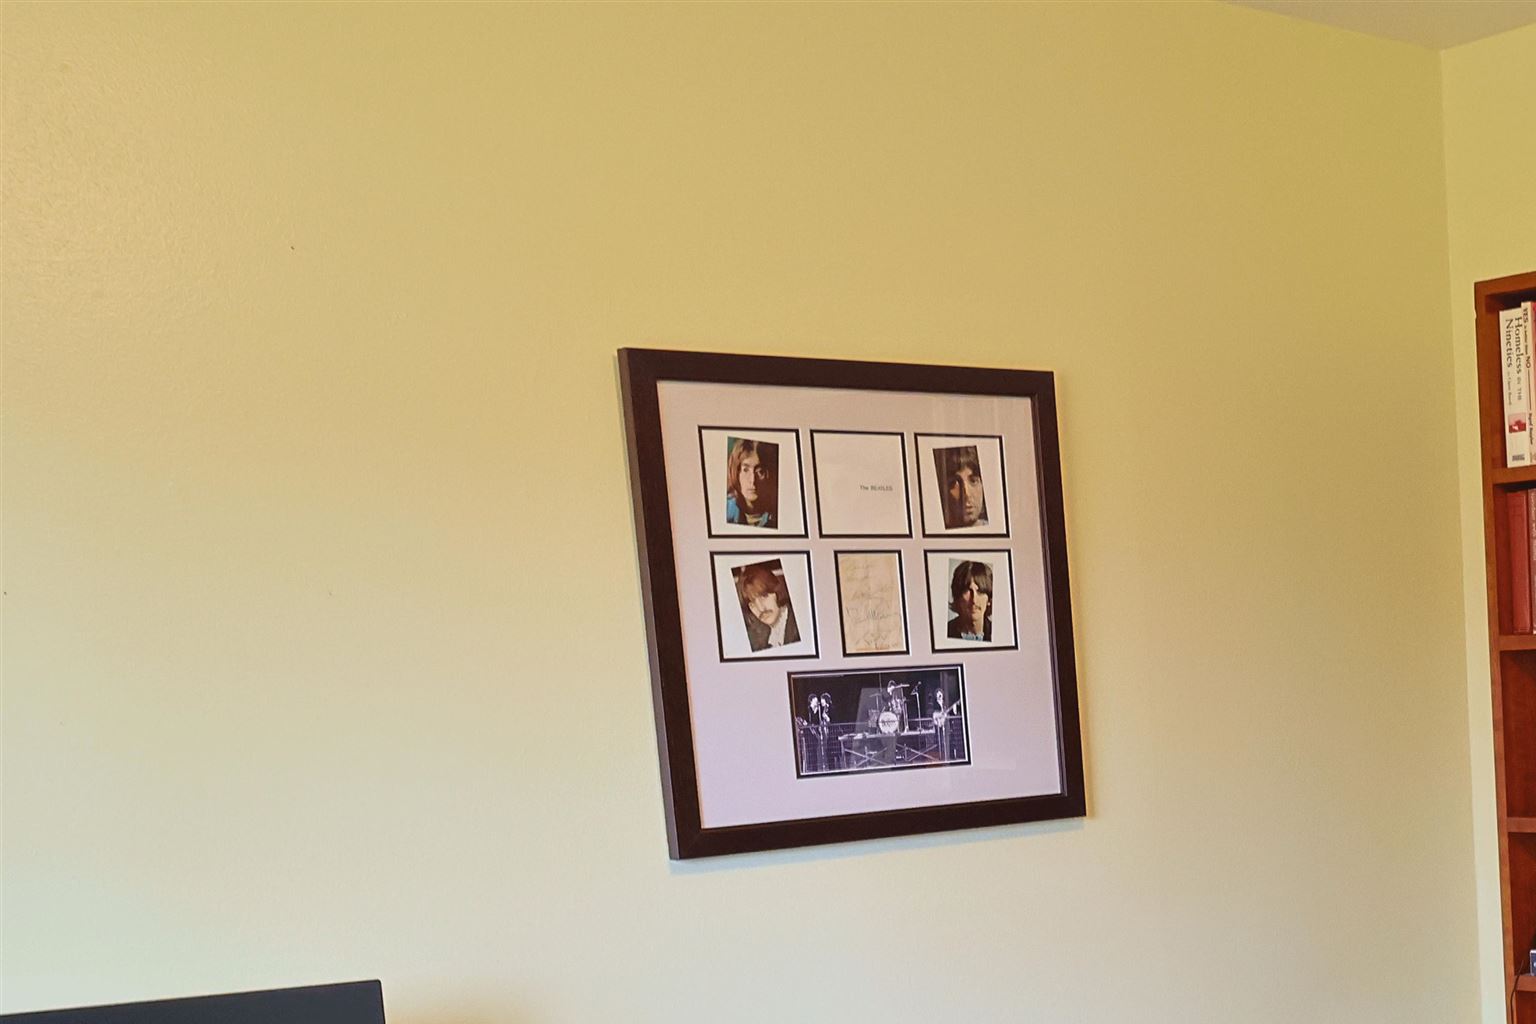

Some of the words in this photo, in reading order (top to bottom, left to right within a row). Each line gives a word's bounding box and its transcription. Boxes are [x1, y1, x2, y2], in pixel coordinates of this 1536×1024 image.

[1505, 319, 1514, 368] Nineties
[1514, 316, 1524, 374] Homeless
[1526, 356, 1531, 368] NO
